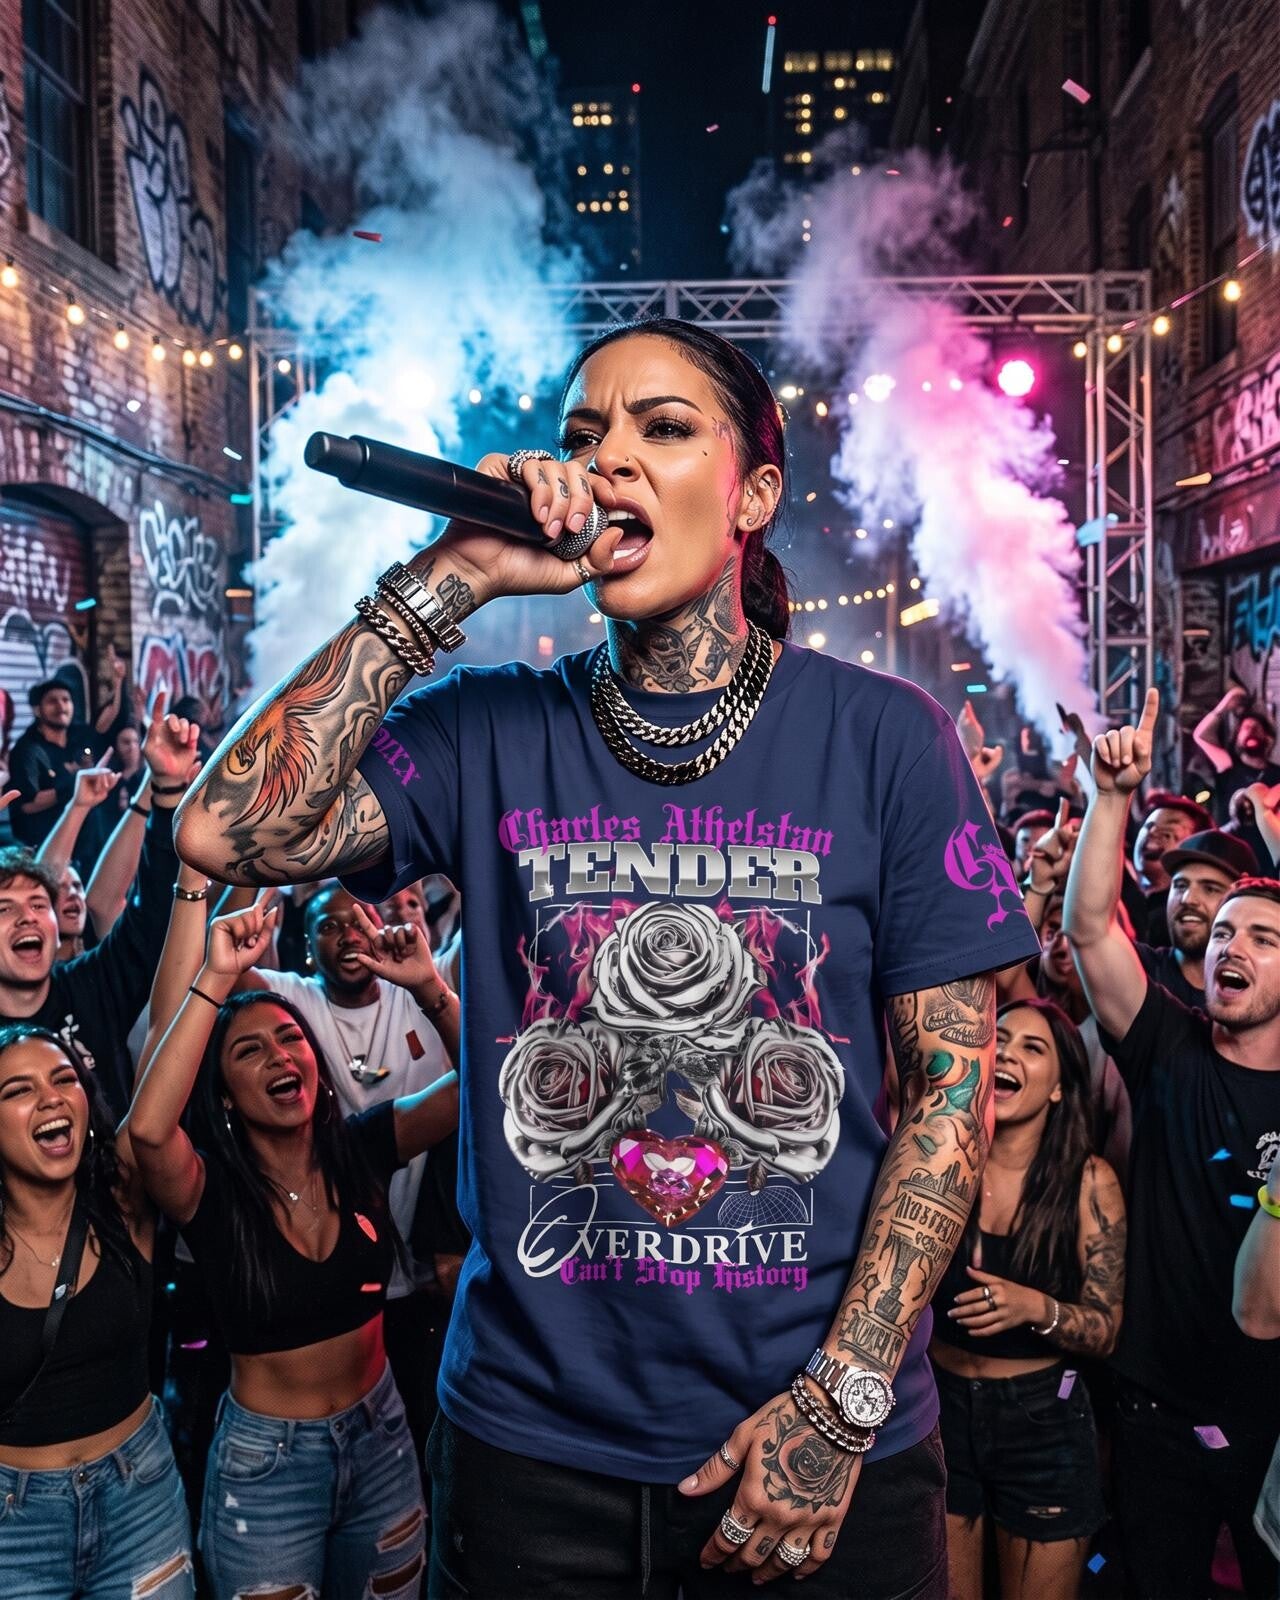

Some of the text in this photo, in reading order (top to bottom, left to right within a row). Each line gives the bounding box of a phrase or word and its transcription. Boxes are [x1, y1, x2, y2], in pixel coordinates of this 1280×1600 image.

[498, 803, 834, 857] Charles Athelstan
[518, 841, 822, 905] TENDER
[559, 1255, 809, 1296] Can't Stop History
